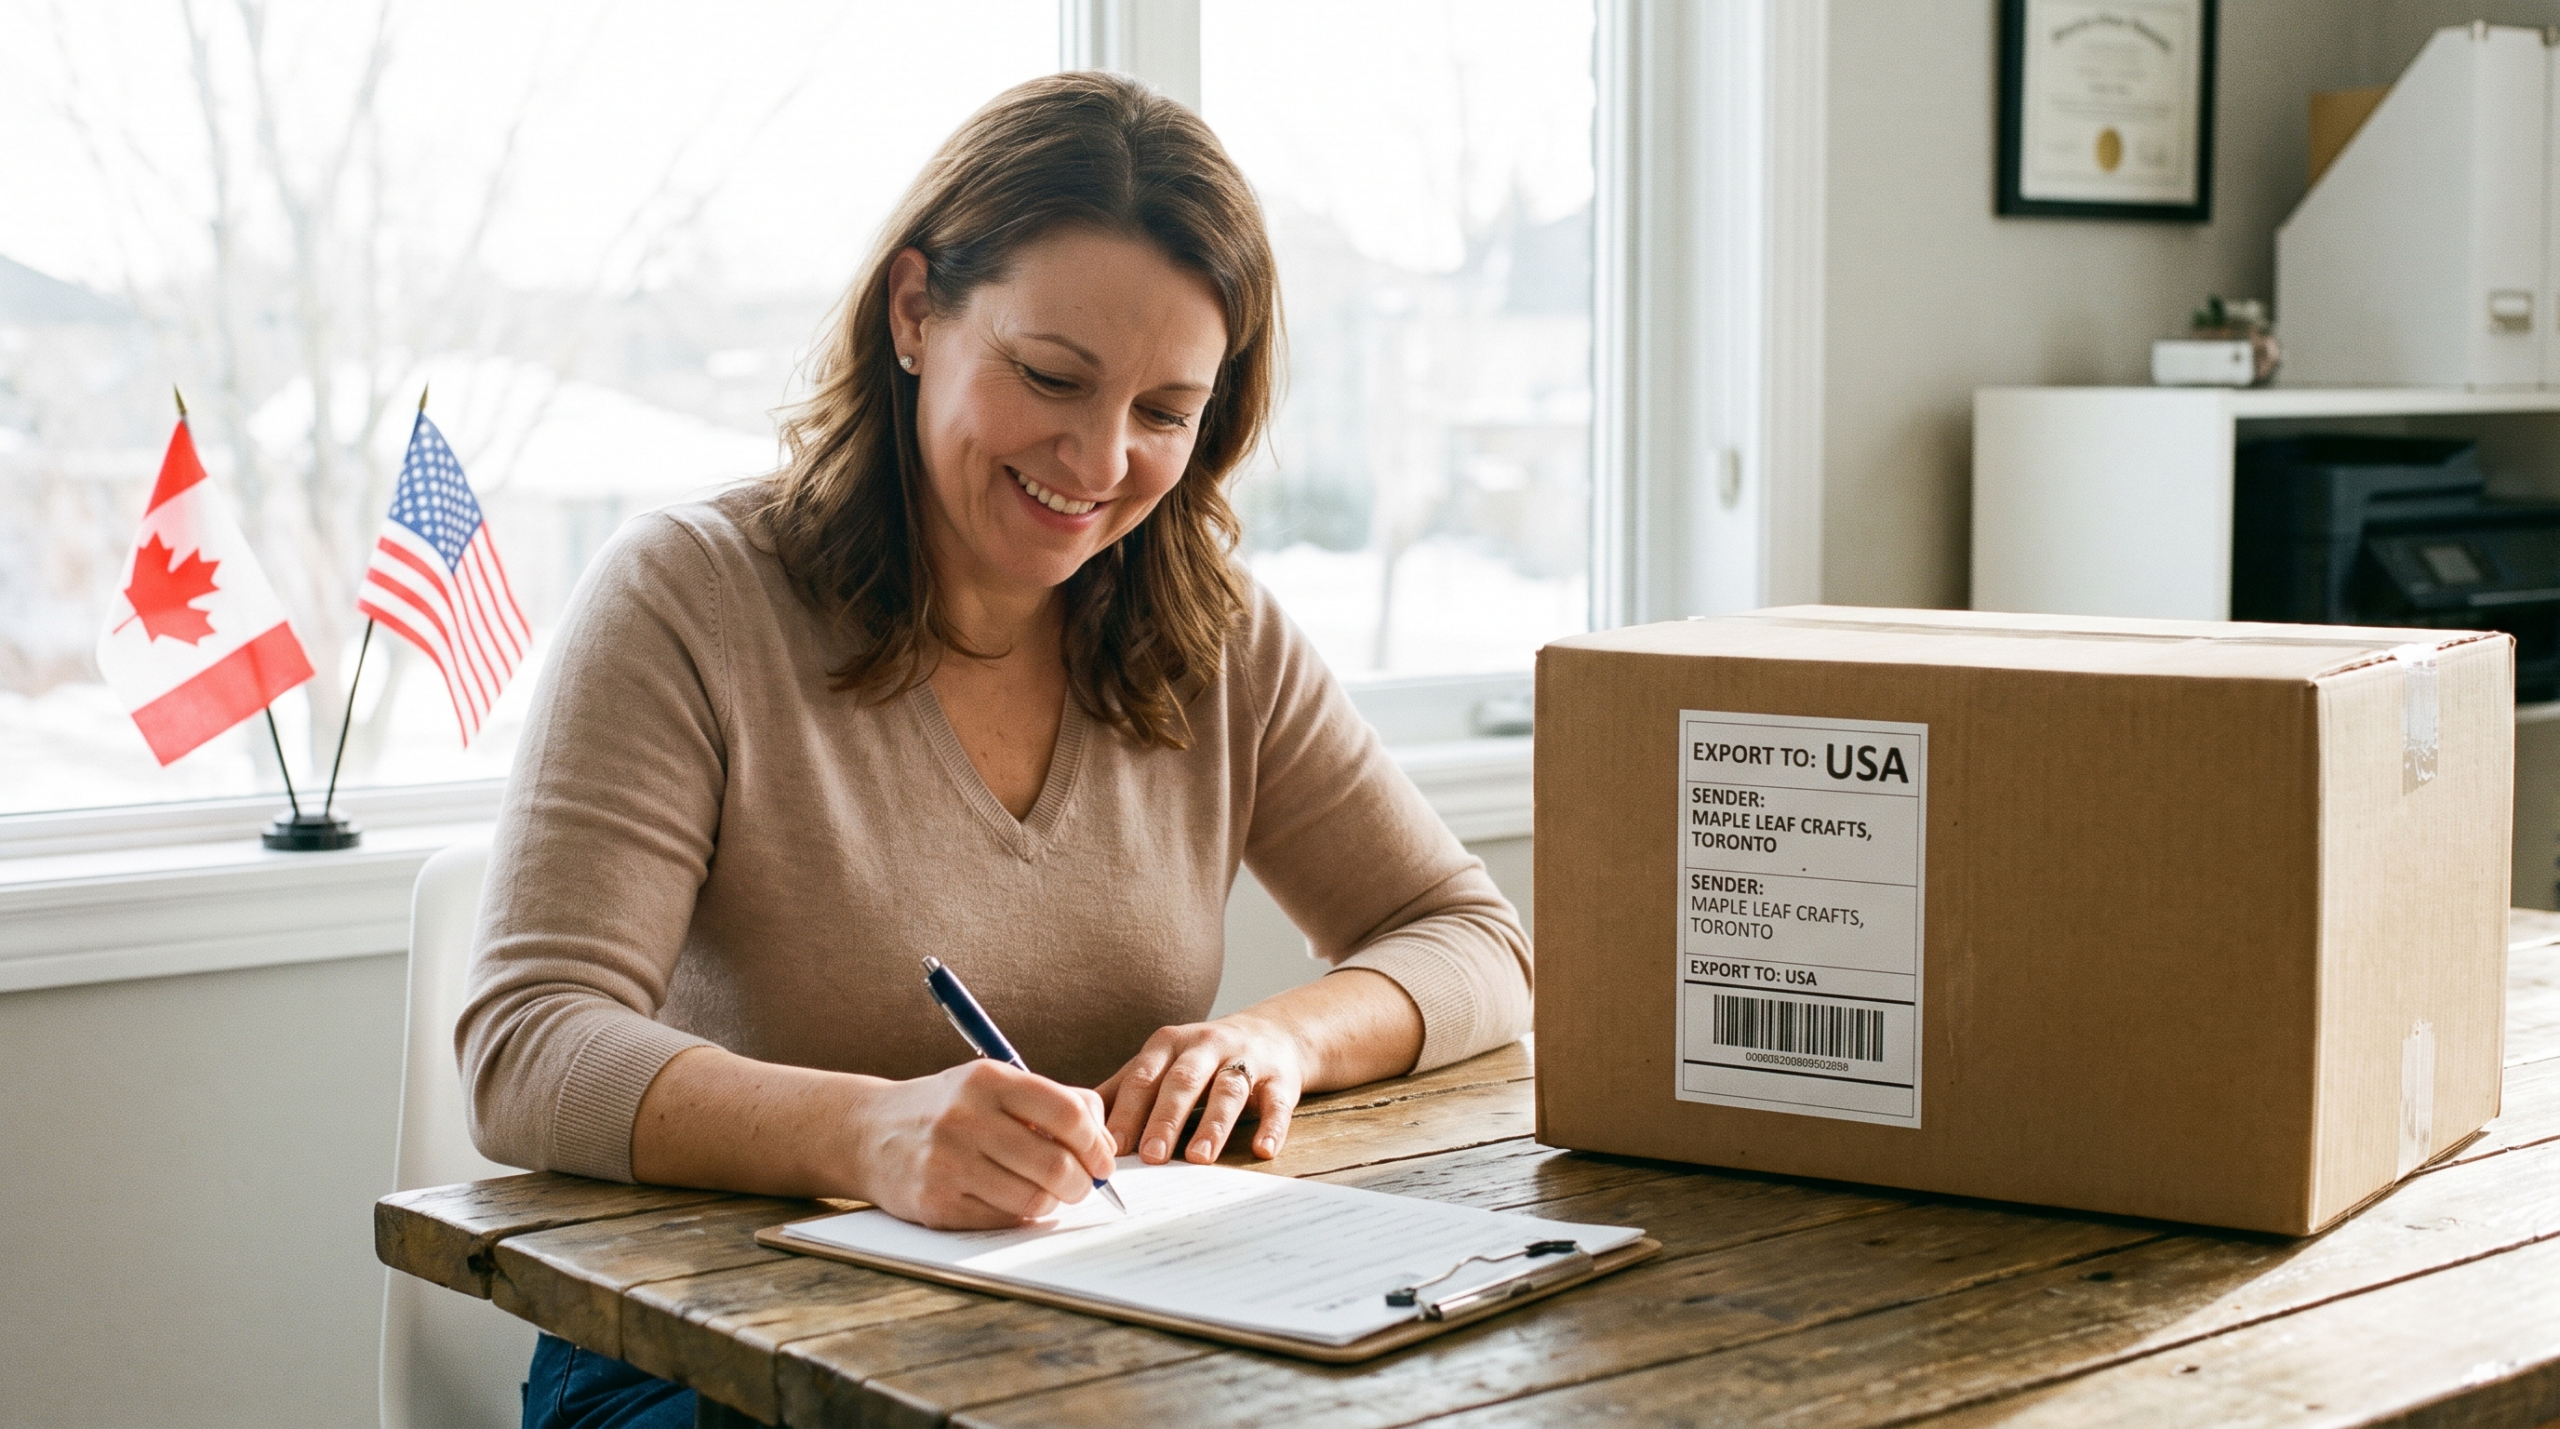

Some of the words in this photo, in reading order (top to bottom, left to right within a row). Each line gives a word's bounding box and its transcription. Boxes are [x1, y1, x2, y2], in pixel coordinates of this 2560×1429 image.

[1693, 742, 1775, 766] EXPORT
[1779, 748, 1817, 769] TO:
[1826, 743, 1910, 784] USA
[1691, 787, 1766, 808] SENDER:
[1692, 810, 1751, 830] MAPLE
[1755, 815, 1797, 833] LEAF
[1800, 818, 1873, 842] CRAFTS,
[1691, 831, 1778, 854] TORONTO
[1690, 873, 1765, 896] SENDER:
[1691, 896, 1748, 916] MAPLE
[1752, 901, 1792, 920] LEAF
[1795, 905, 1865, 929] CRAFTS,
[1690, 917, 1774, 940] TORONTO
[1690, 960, 1751, 981] EXPORT
[1754, 966, 1781, 983] TO:
[1785, 969, 1818, 987] USA
